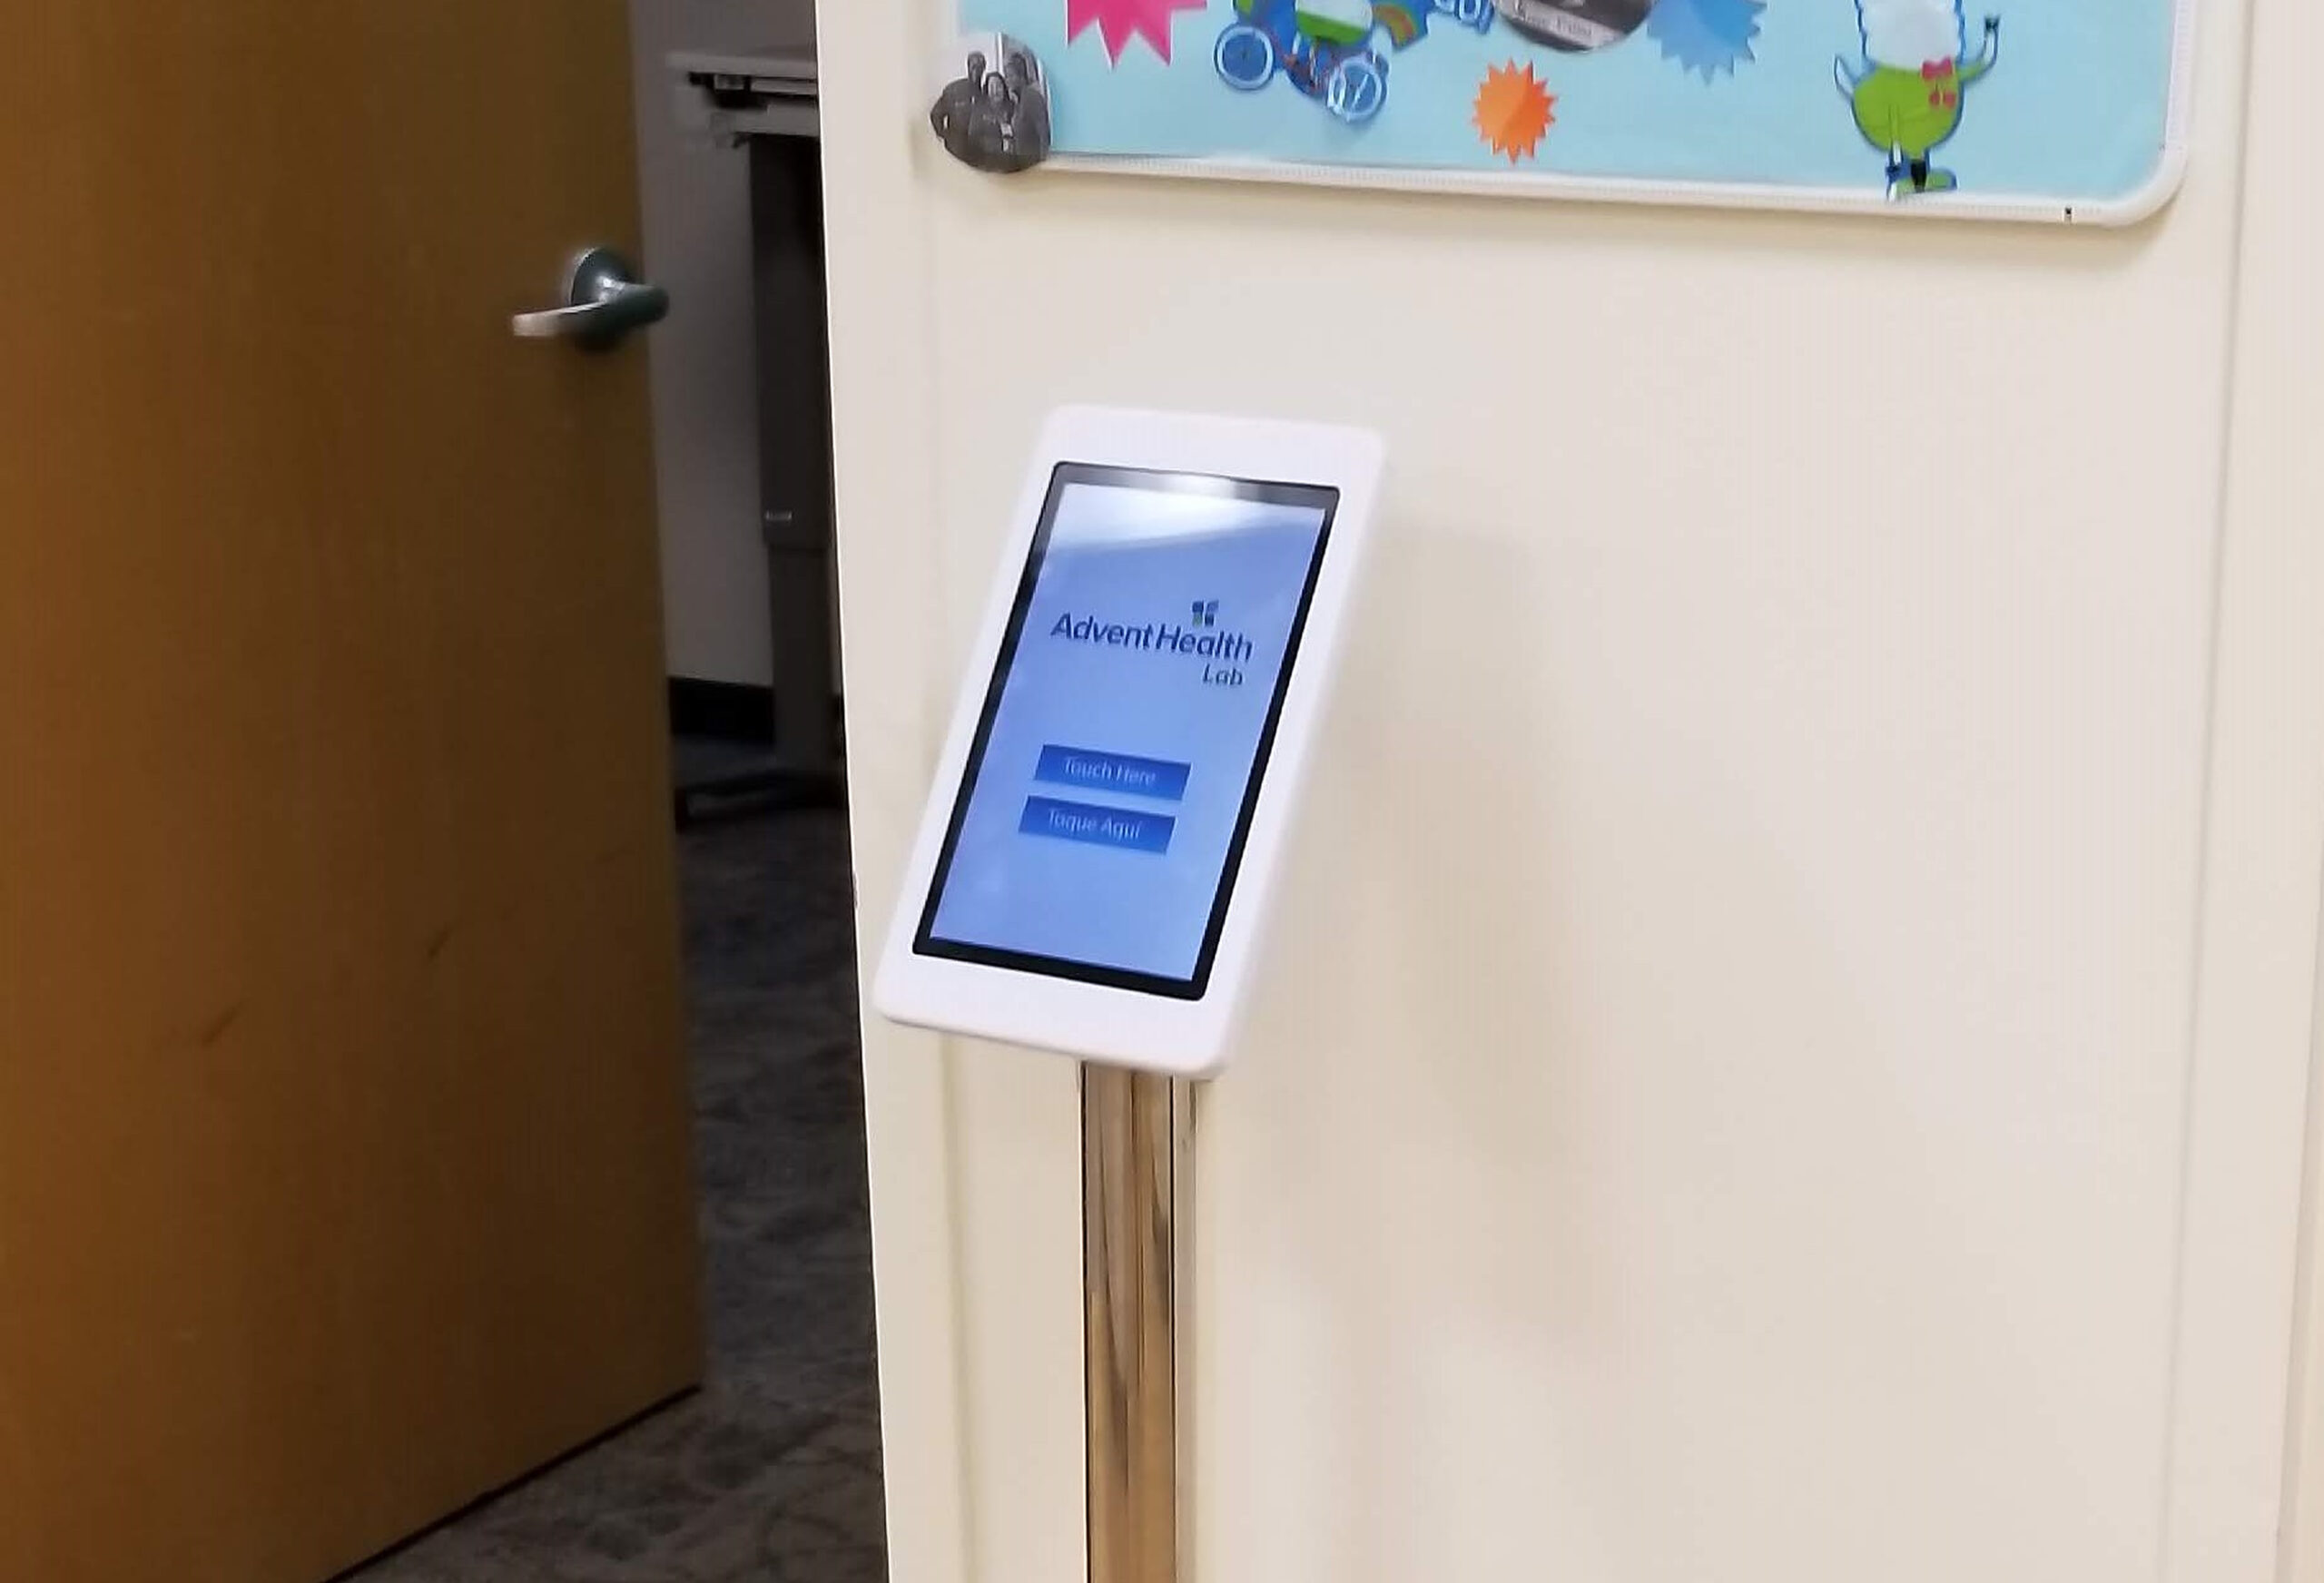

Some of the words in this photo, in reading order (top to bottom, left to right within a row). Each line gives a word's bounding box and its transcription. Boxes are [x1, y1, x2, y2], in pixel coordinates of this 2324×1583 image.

[1050, 612, 1253, 662] AdventHealth
[1202, 664, 1244, 686] Lab
[1065, 756, 1112, 781] Touch
[1117, 764, 1157, 786] Here
[1049, 808, 1097, 833] Toque
